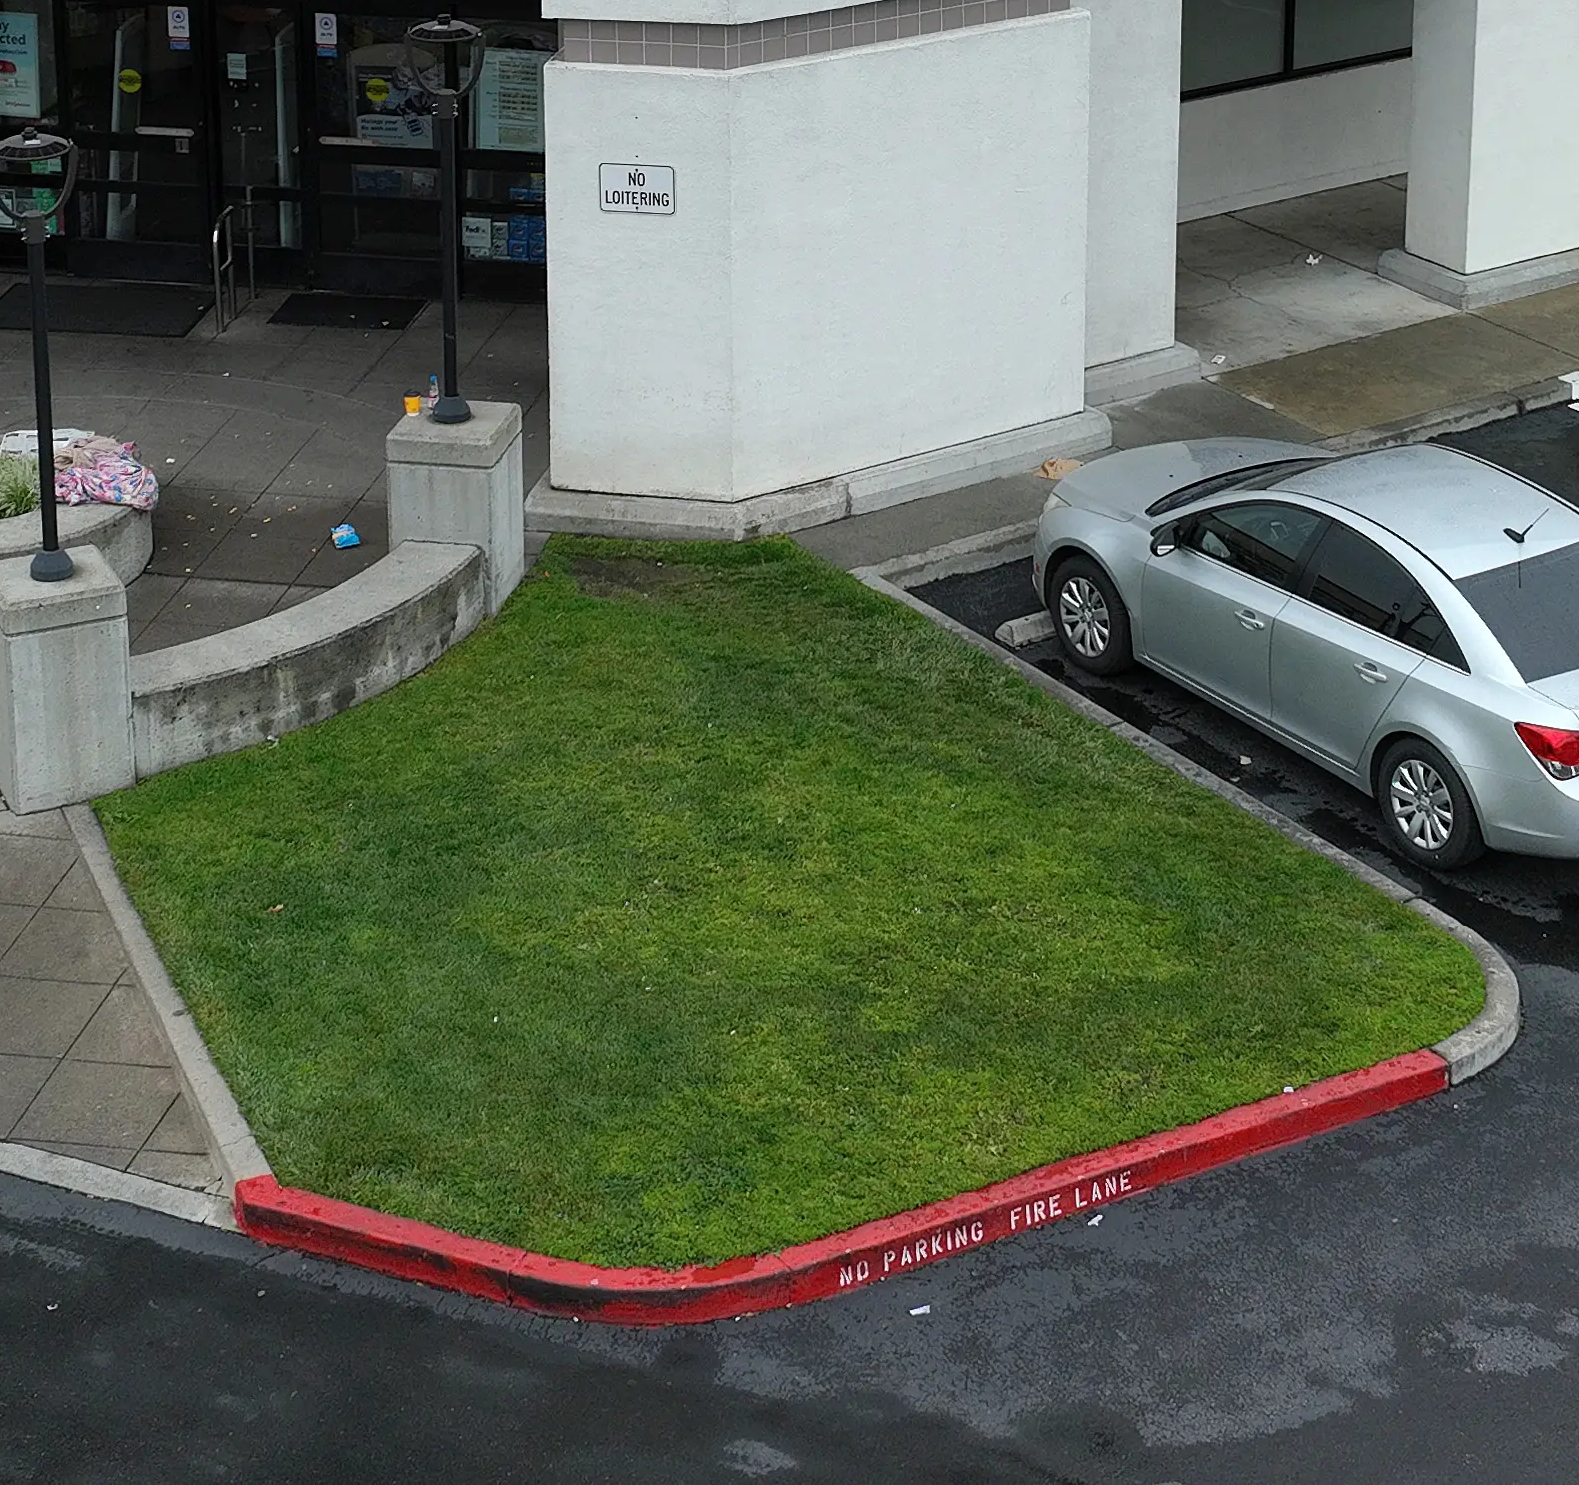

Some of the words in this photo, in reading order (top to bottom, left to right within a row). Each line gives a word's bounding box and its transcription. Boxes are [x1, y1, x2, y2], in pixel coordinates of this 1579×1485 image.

[628, 172, 646, 186] NO
[605, 190, 670, 207] LOITERING
[839, 1259, 870, 1286] NO
[883, 1221, 984, 1272] PARKING
[1010, 1193, 1063, 1230] FIRE
[1074, 1169, 1133, 1208] LANE
